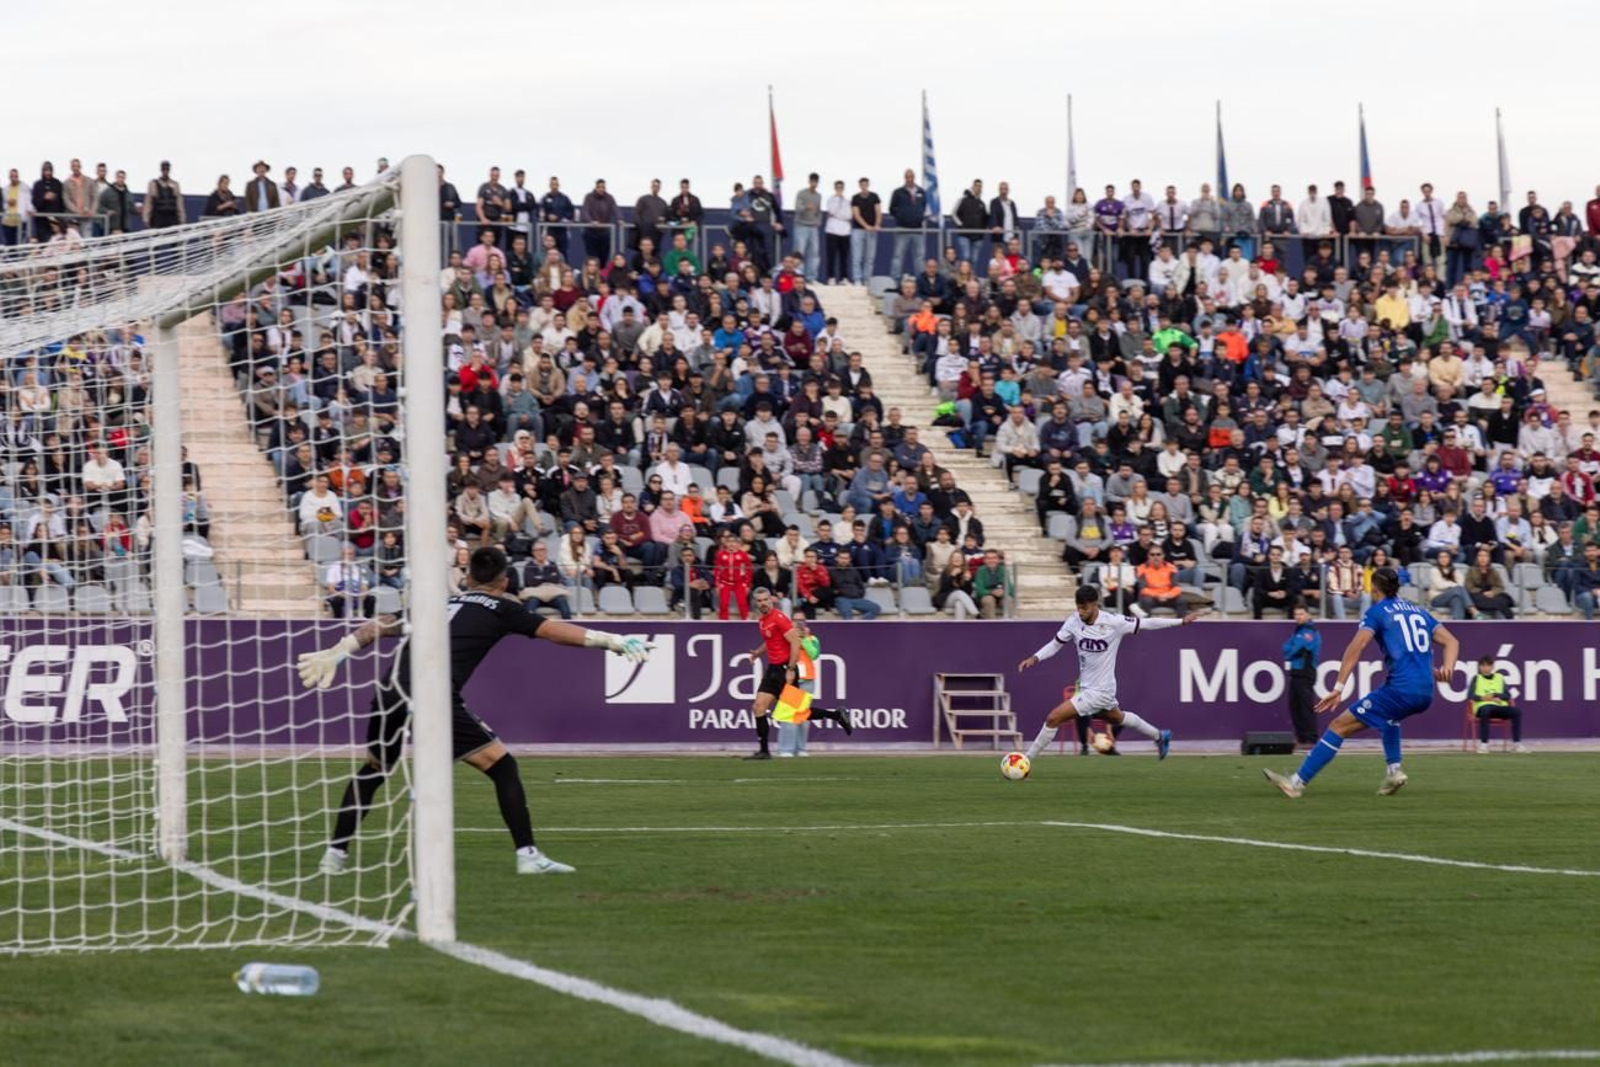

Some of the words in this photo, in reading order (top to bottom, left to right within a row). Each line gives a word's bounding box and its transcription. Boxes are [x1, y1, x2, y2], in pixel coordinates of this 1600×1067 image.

[1393, 613, 1430, 653] 16
[687, 633, 846, 703] Jan
[1179, 648, 1383, 704] Moor
